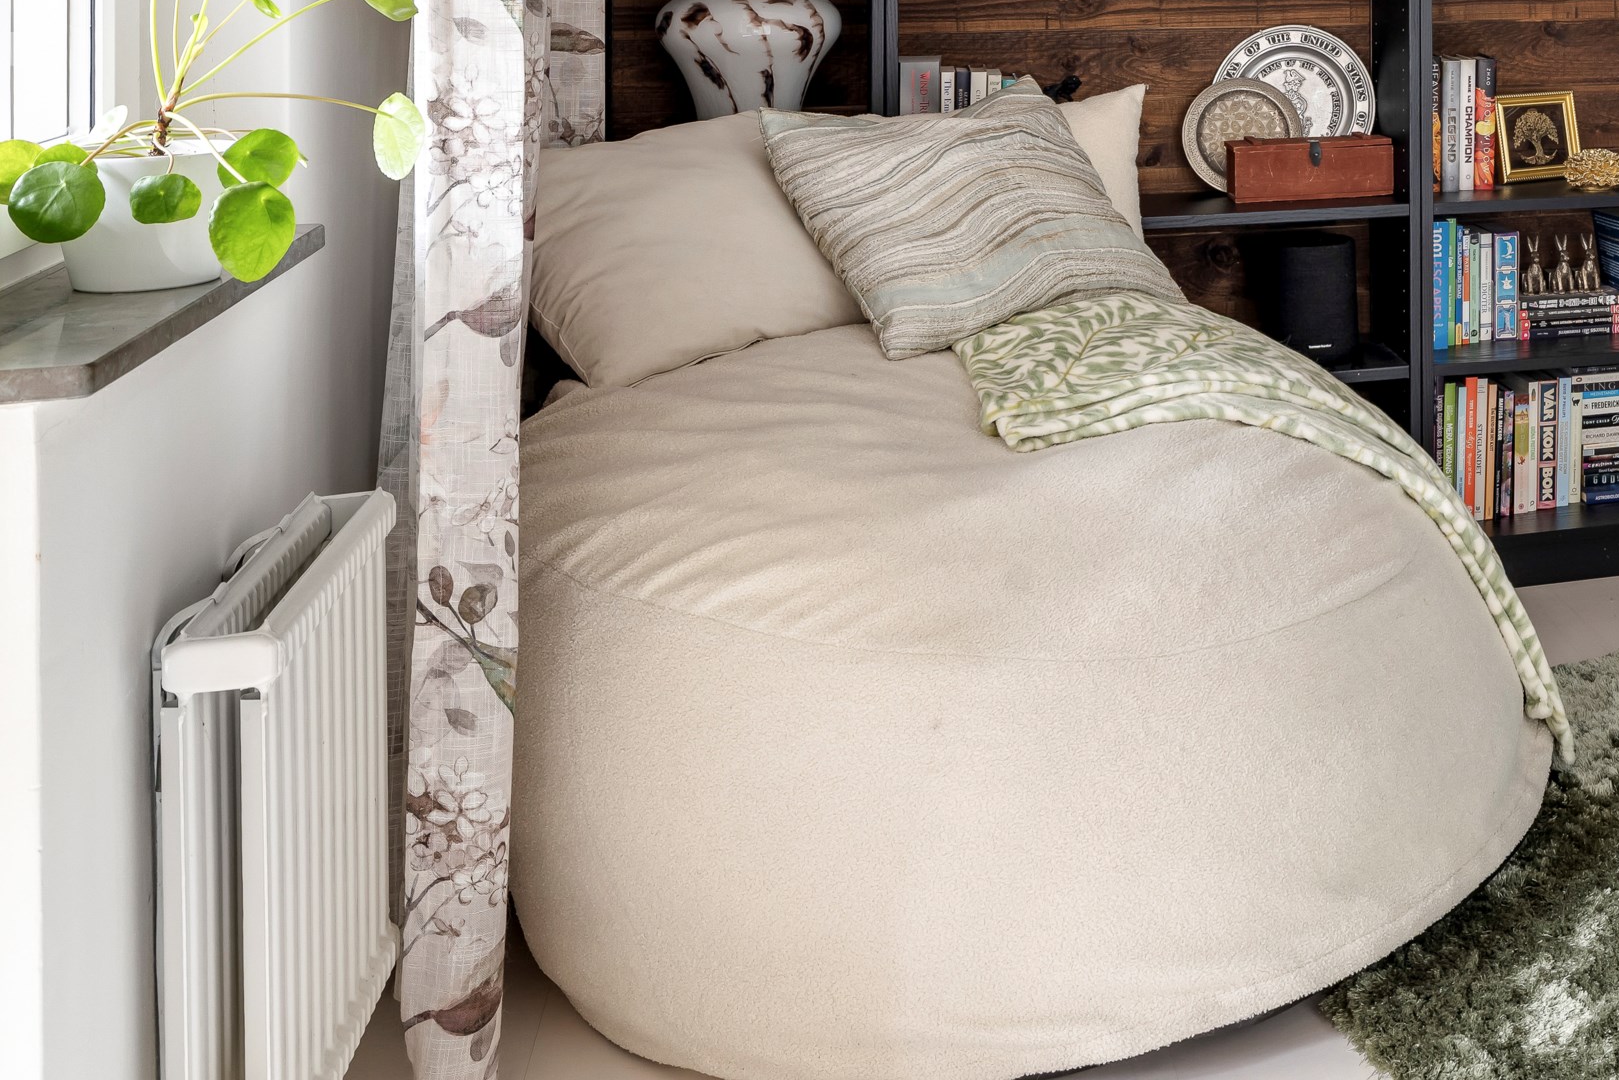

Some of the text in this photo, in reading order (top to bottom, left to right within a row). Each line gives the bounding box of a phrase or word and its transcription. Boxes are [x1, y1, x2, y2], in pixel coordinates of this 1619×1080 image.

[1244, 32, 1367, 128] OF THE UNITED STATES OF
[1259, 59, 1340, 134] ARMS OF THE FIRST PRESIDENT
[1447, 108, 1457, 163] LEGEND
[1464, 106, 1473, 163] CHAMPION
[1434, 228, 1442, 319] 1001 ESCAPES
[1584, 381, 1616, 391] KING
[1591, 400, 1619, 409] FREDERICK
[1542, 387, 1556, 501] VÅR KOK BOK
